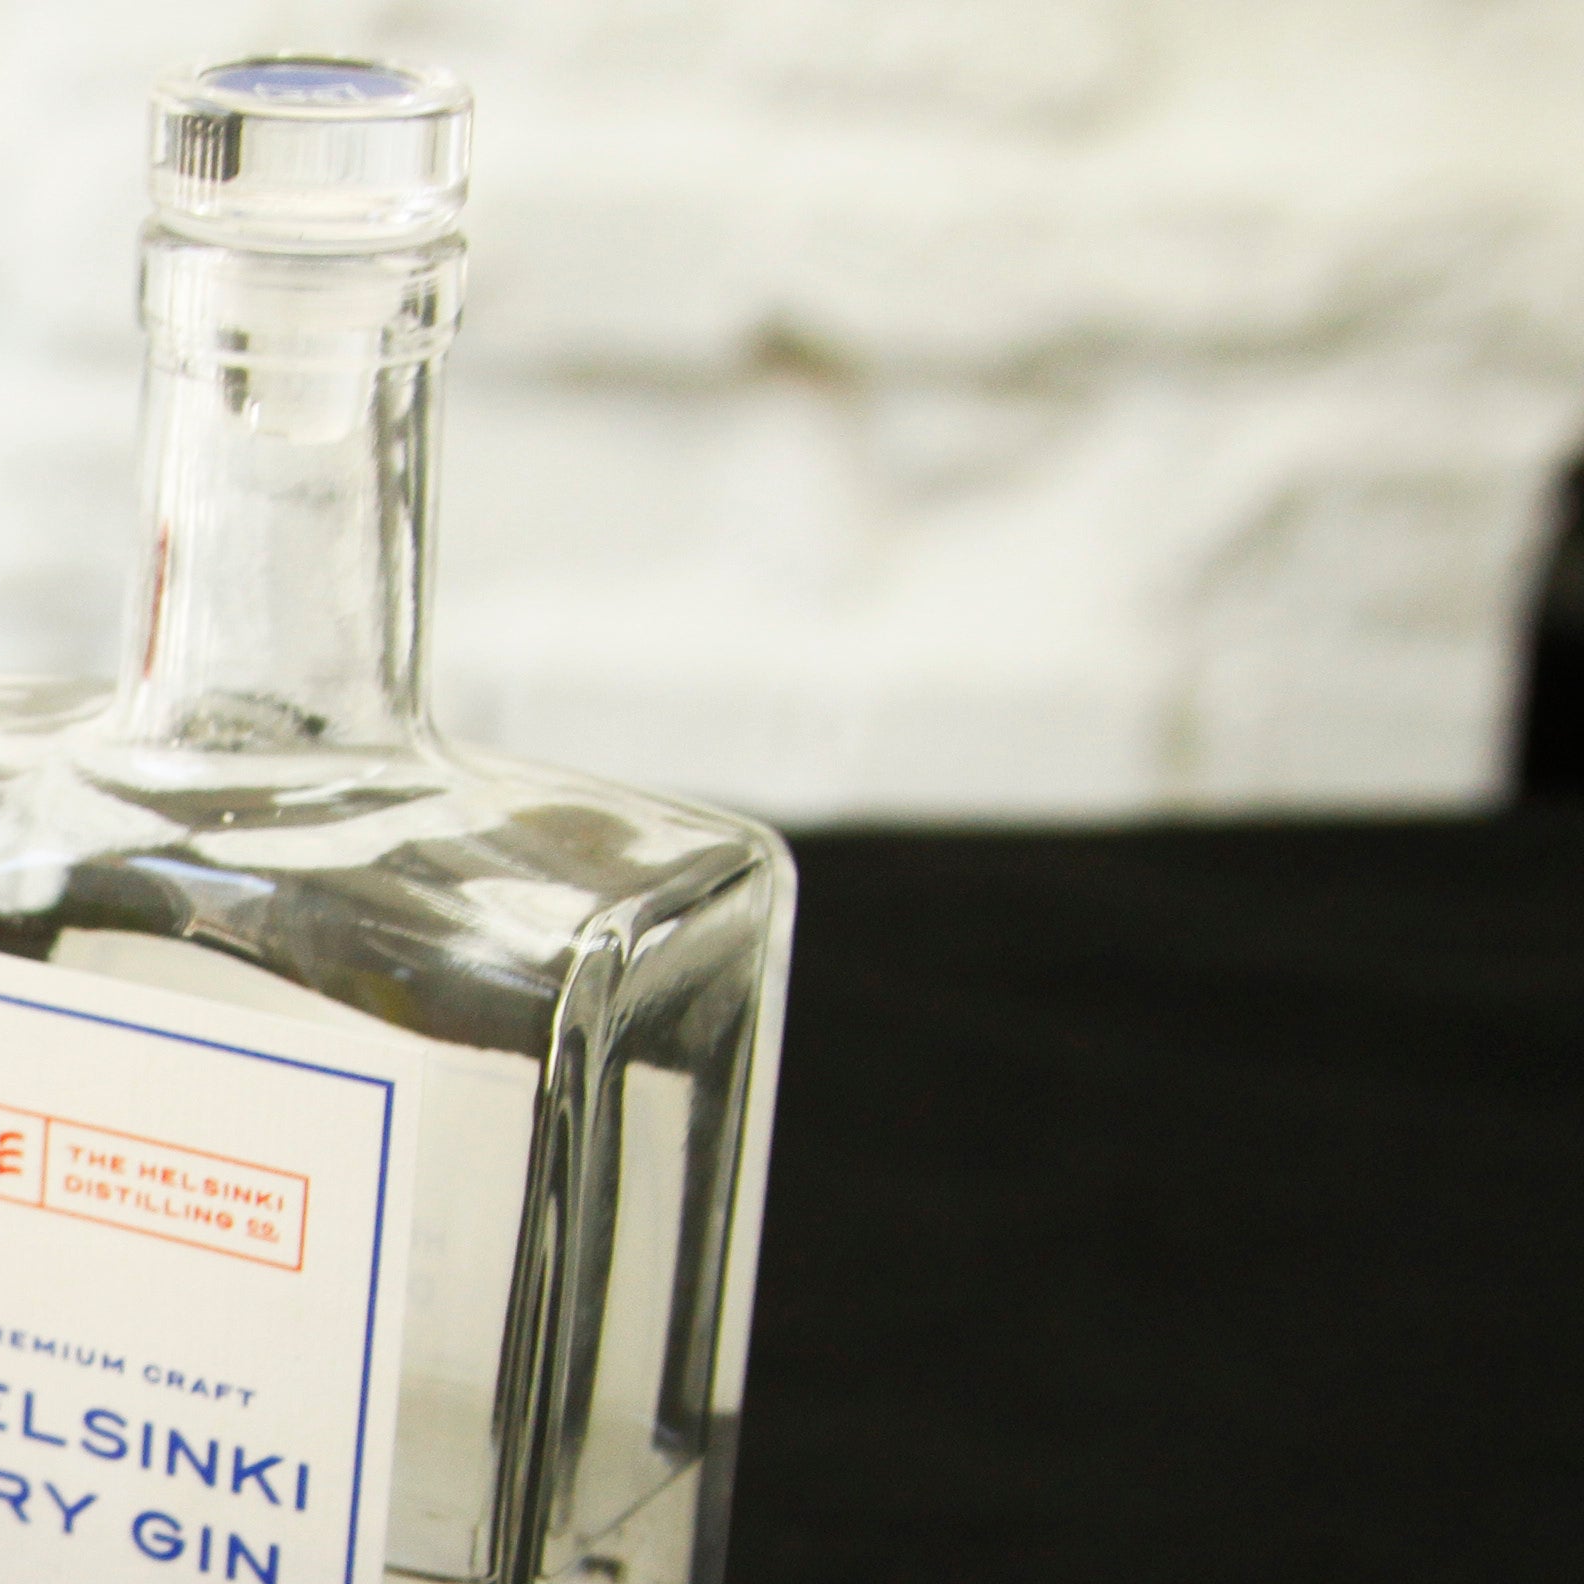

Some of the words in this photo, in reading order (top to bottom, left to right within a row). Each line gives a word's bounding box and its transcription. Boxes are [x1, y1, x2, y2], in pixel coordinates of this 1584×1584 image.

[63, 1173, 235, 1231] DISTILLING
[67, 1142, 127, 1175] THE
[138, 1161, 286, 1213] HELSINKI
[143, 1357, 259, 1409] CRAFT
